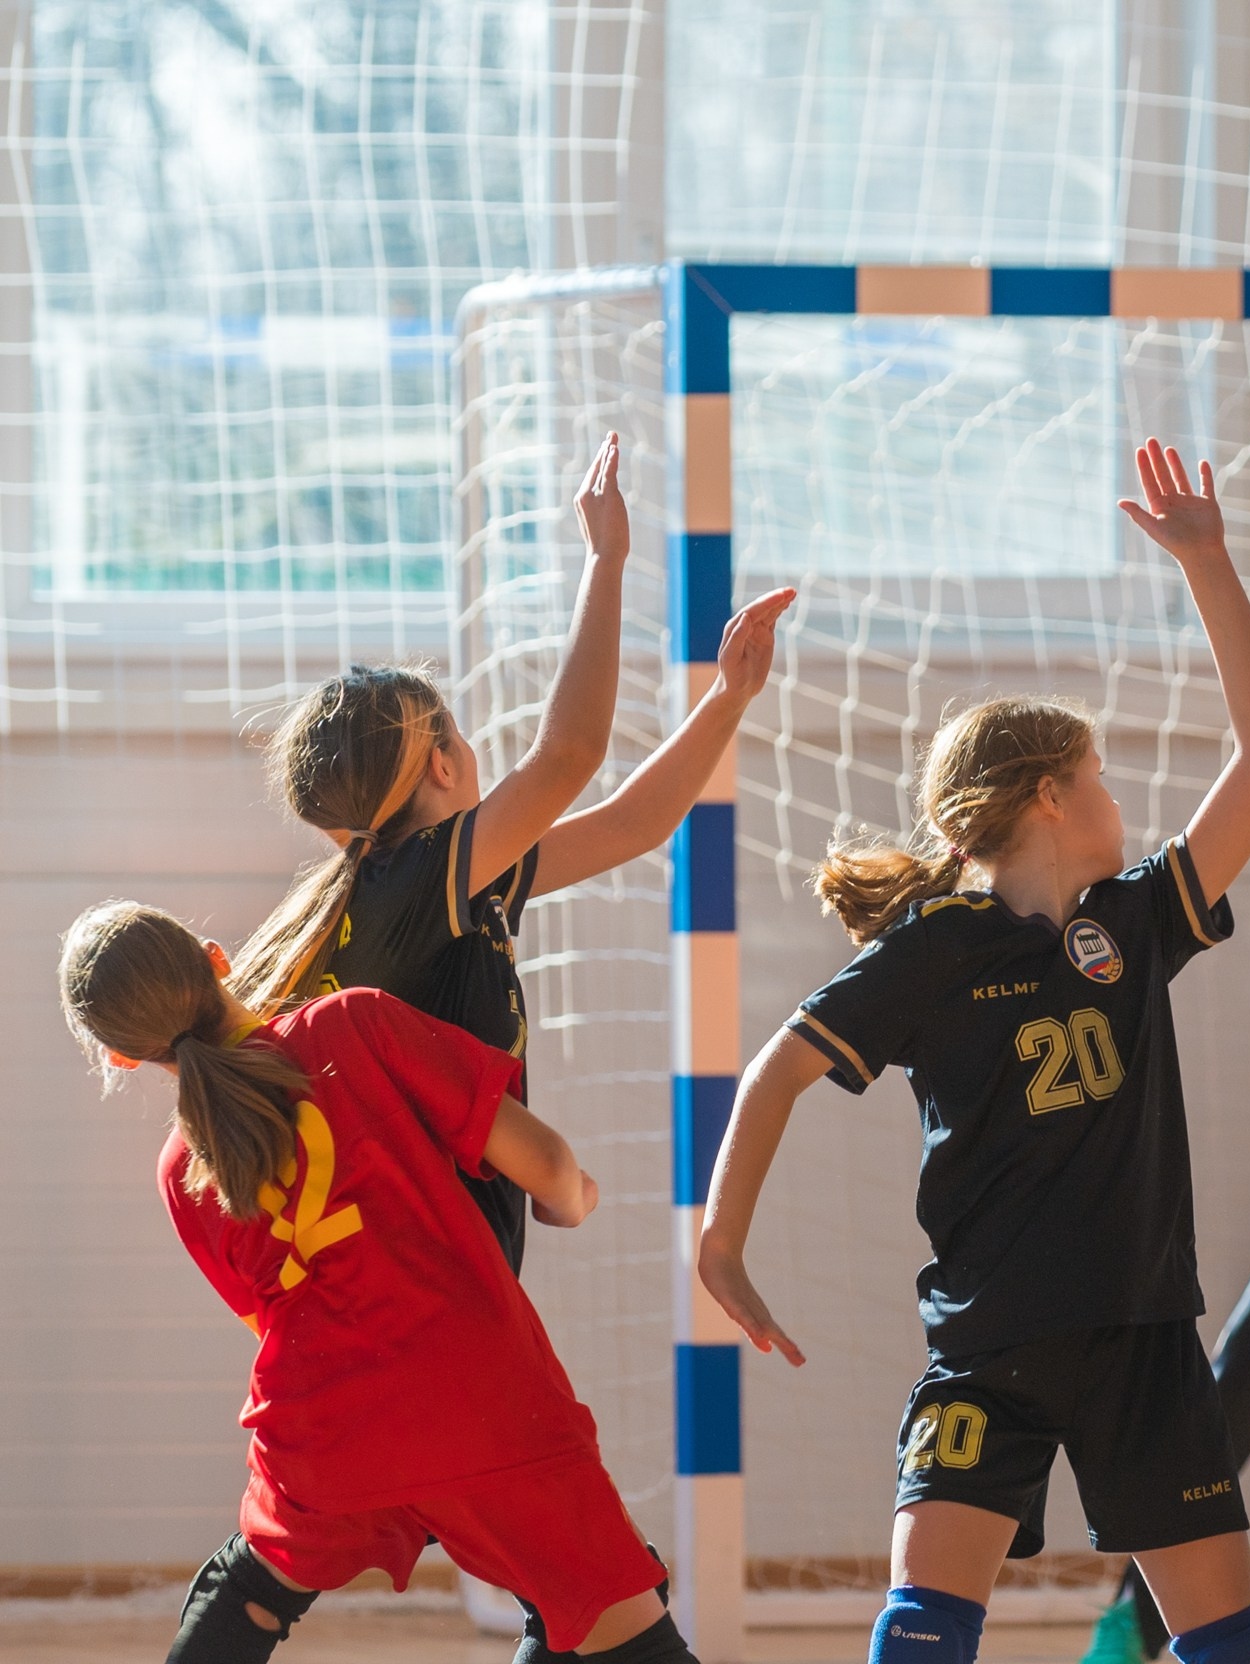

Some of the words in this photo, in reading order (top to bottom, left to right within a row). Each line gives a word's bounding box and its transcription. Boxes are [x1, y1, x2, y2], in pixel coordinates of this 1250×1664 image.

[1015, 1007, 1126, 1115] 20
[902, 1401, 988, 1475] 20
[1183, 1480, 1232, 1502] KELME
[902, 1631, 941, 1642] LARSEN
